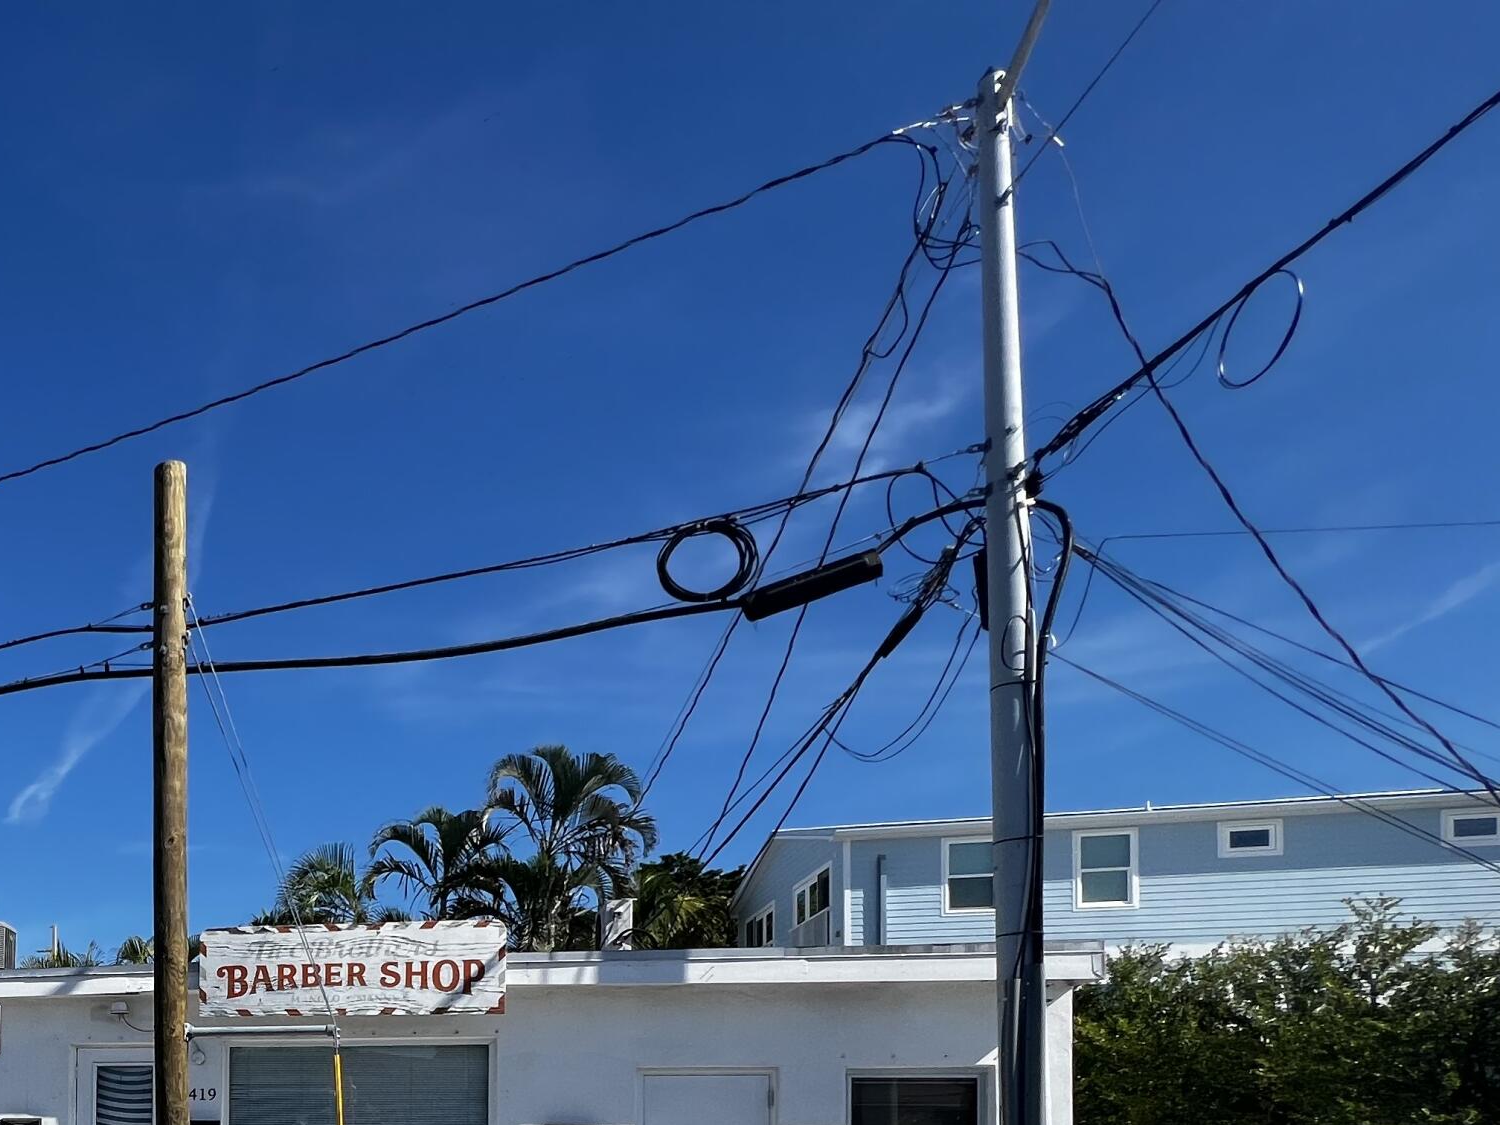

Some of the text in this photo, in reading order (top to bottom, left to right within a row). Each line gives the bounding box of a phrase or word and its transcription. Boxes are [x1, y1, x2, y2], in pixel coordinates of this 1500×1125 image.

[216, 959, 485, 999] BARBER SHOP
[188, 1087, 217, 1101] 419
